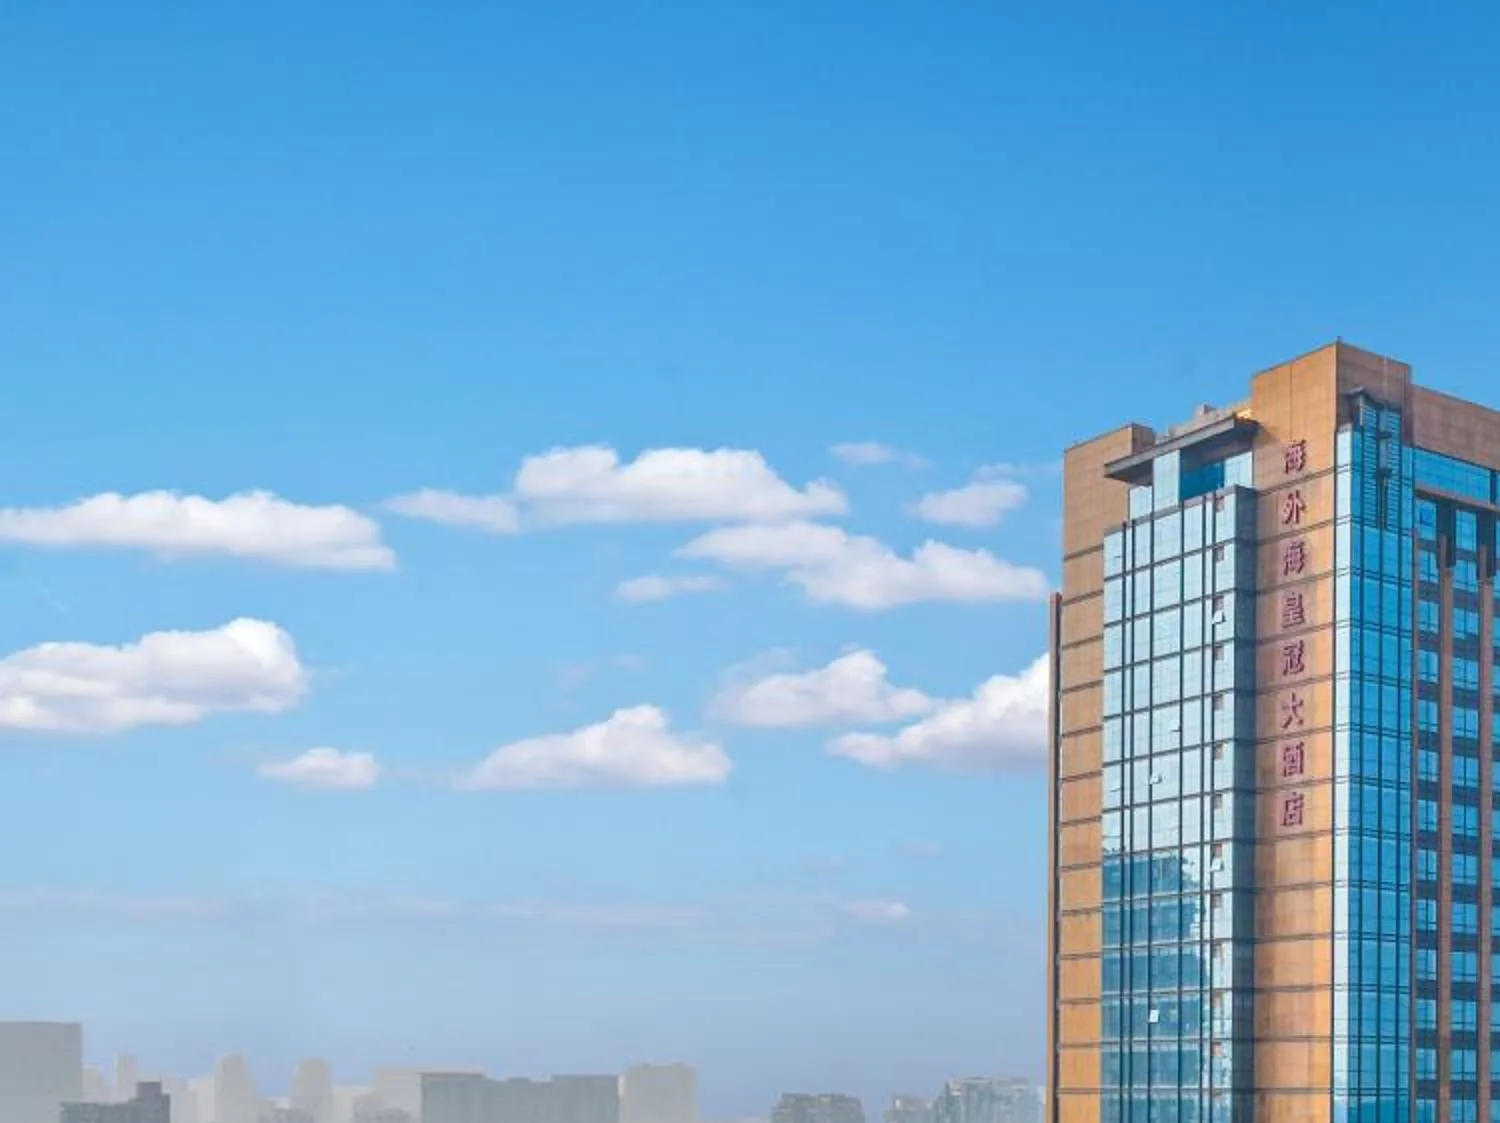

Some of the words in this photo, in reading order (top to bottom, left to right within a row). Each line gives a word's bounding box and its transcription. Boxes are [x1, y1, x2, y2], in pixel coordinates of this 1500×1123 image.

[1281, 439, 1307, 828] 海外海皇冠大酒店
